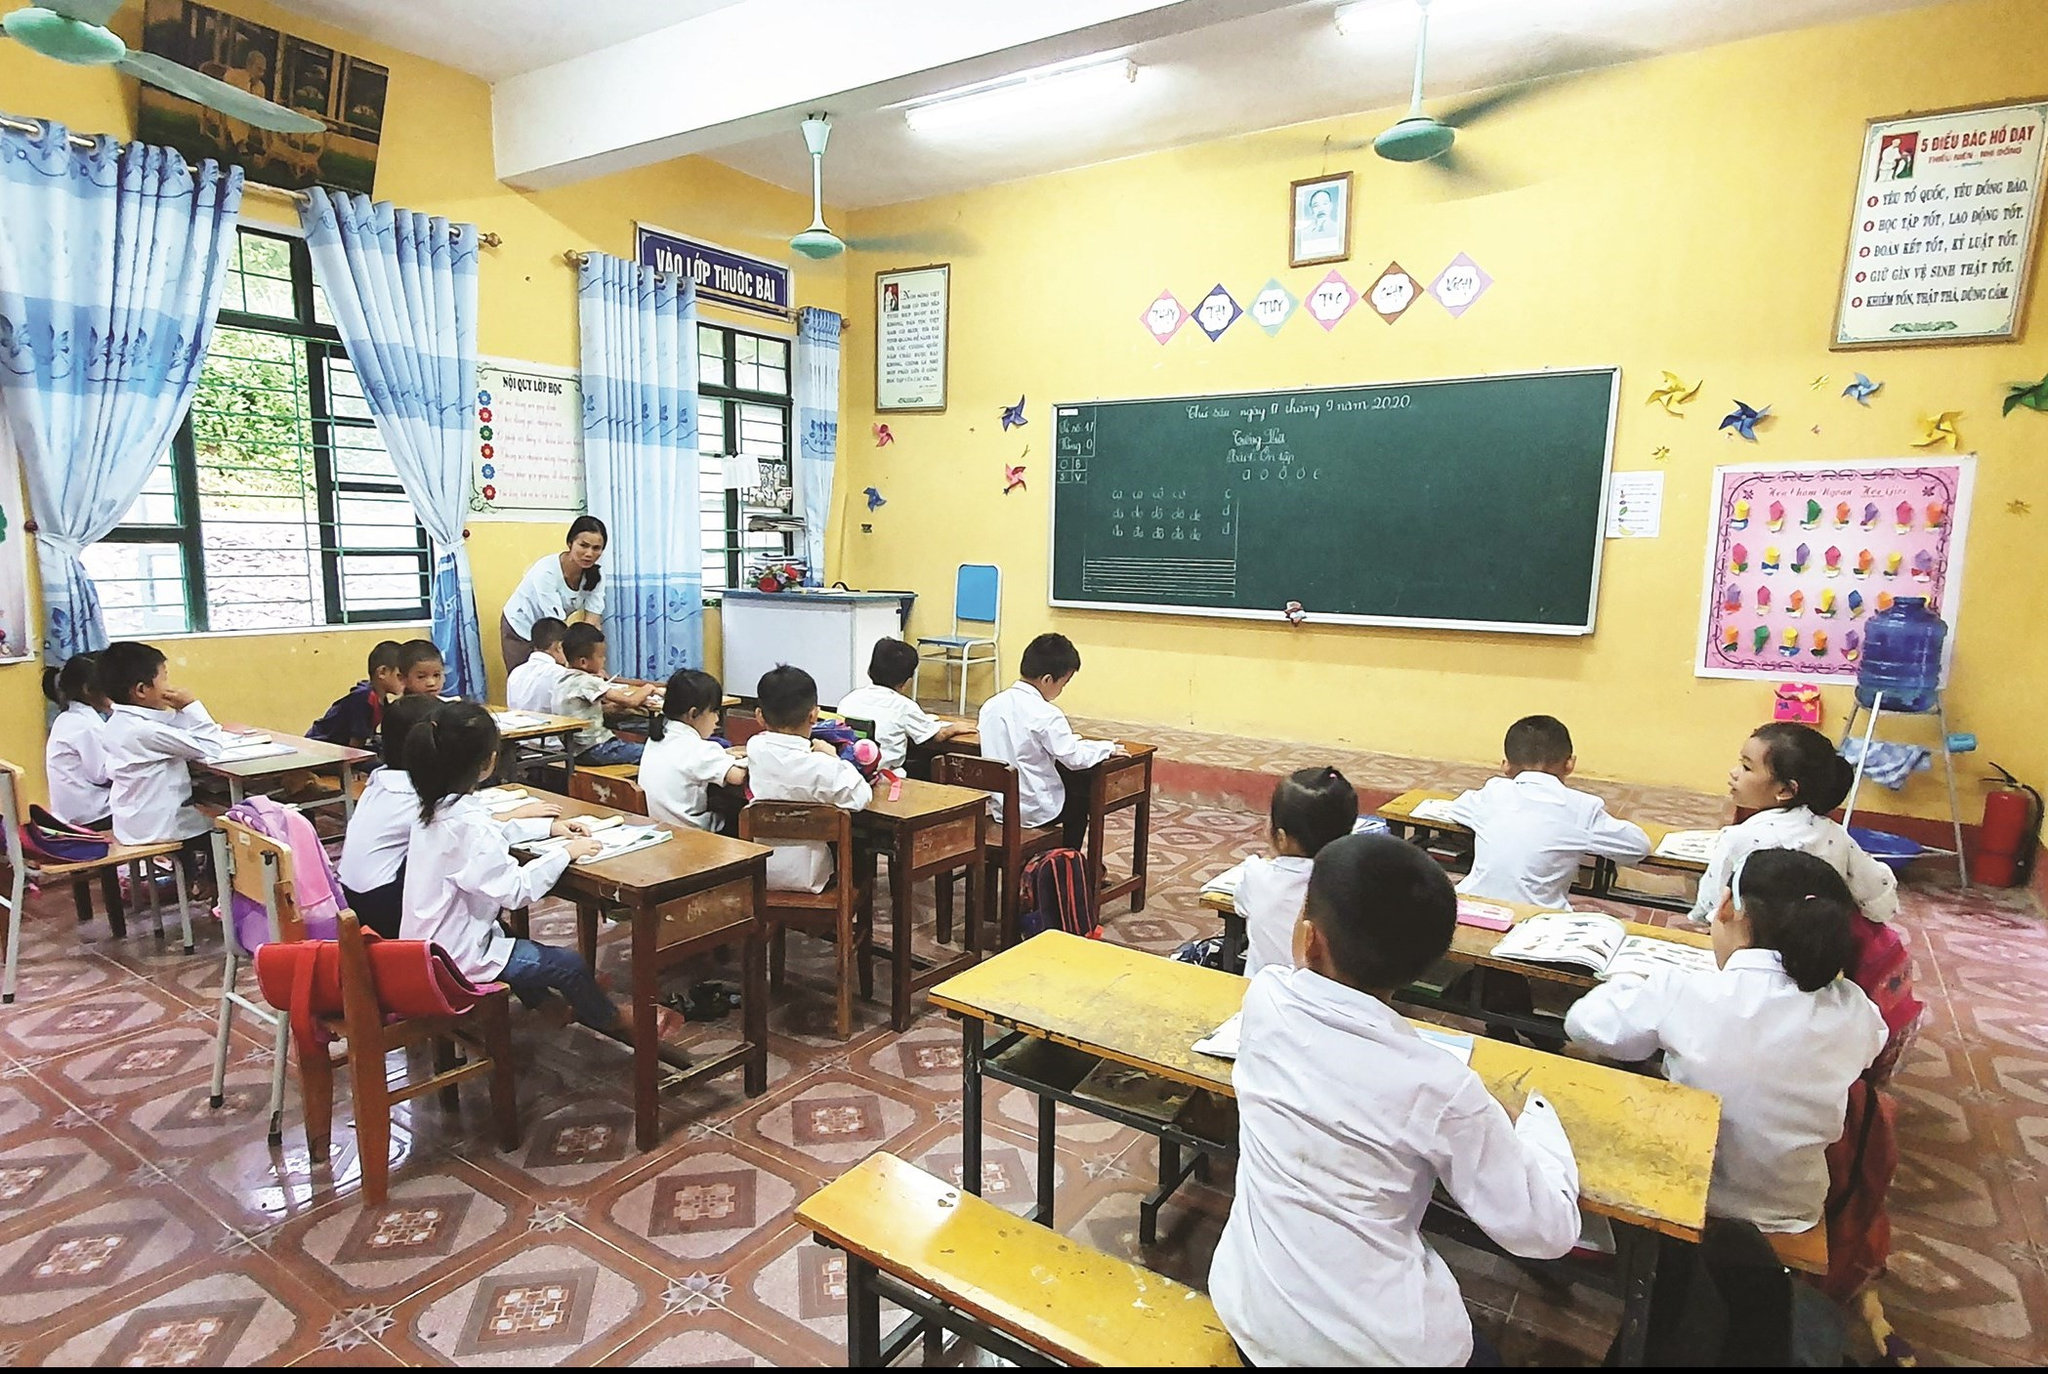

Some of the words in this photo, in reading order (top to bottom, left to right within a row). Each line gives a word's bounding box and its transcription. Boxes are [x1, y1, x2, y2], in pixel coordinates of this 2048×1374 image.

[1920, 138, 1929, 152] 5
[655, 246, 683, 277] VÀO
[756, 272, 776, 302] BÀI
[1326, 399, 1333, 412] 9
[1371, 394, 1411, 409] 2020
